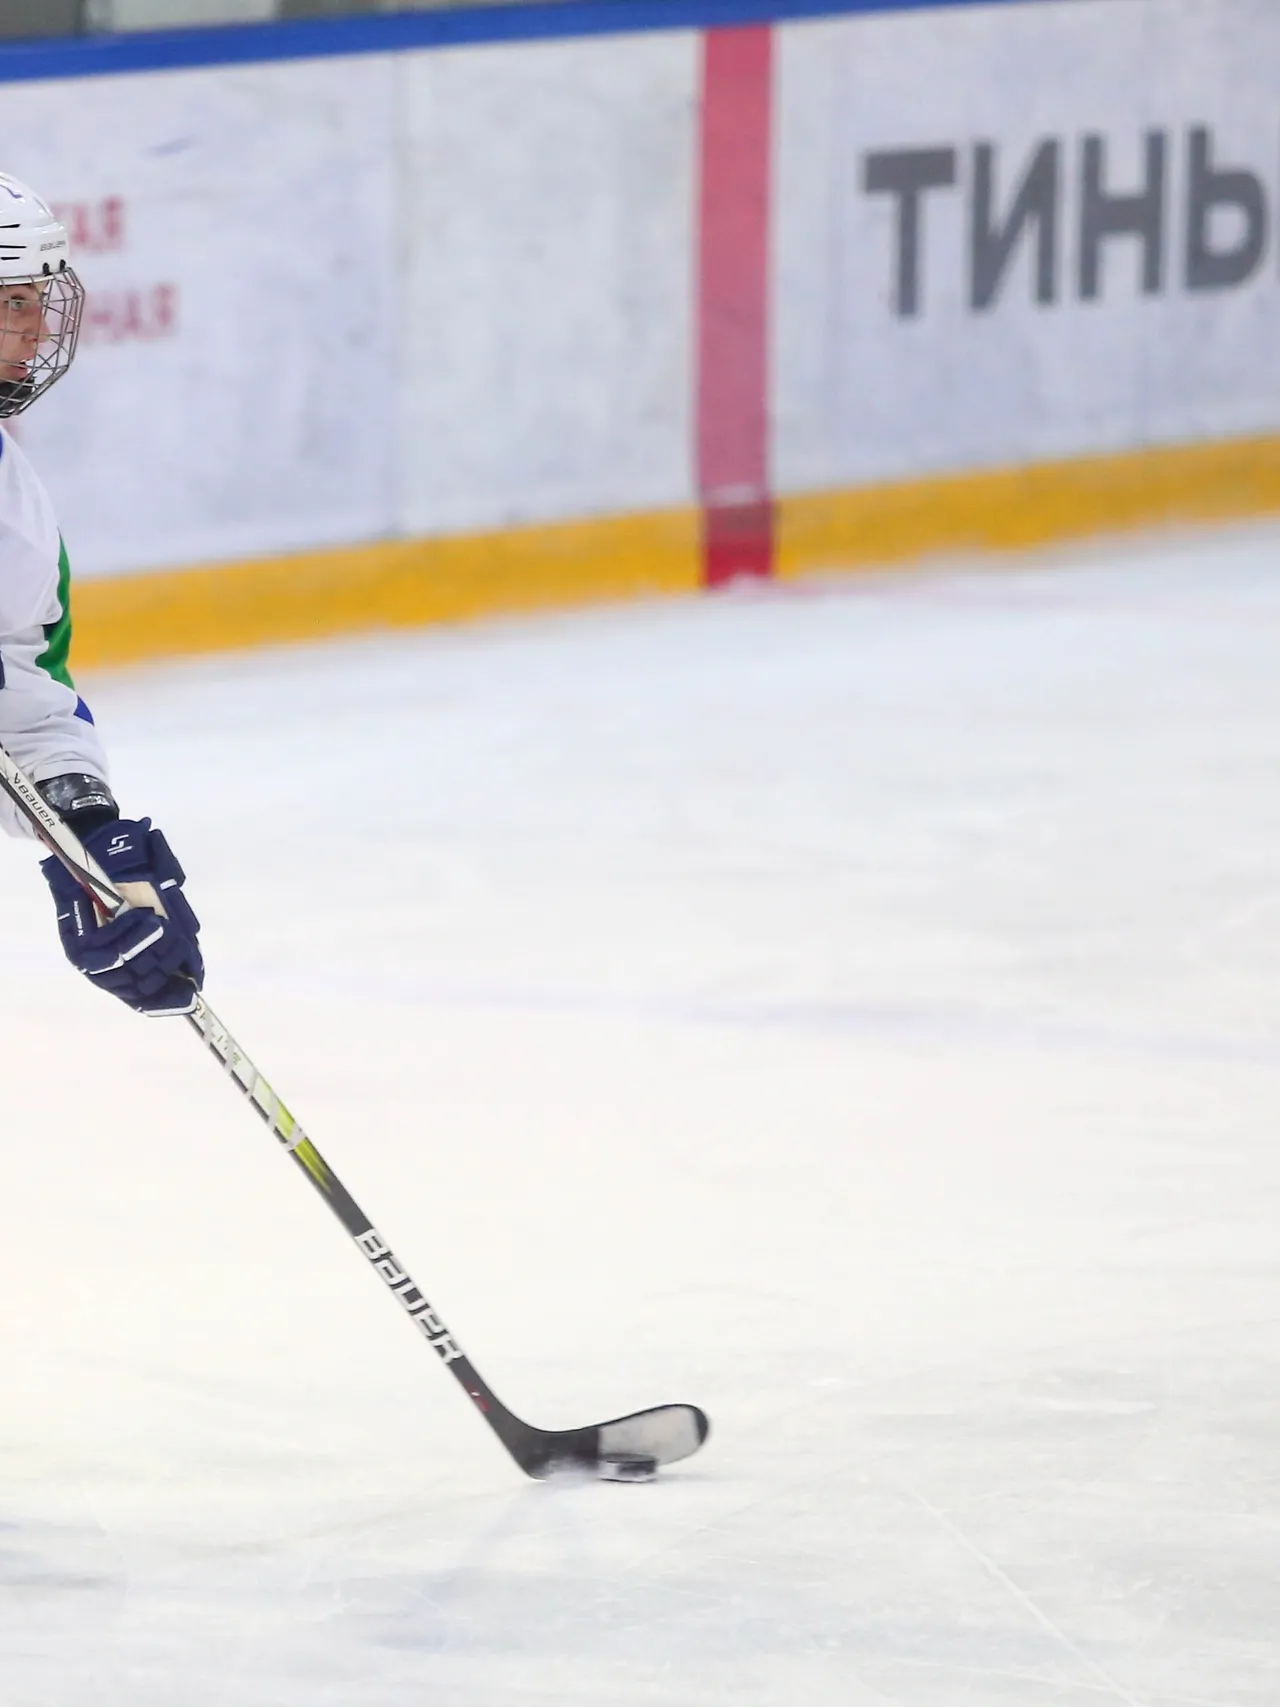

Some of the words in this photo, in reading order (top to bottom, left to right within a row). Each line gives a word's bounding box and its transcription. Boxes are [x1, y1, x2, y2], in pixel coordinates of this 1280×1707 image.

[864, 123, 1280, 318] ТИНЬ
[18, 784, 56, 829] BAUER
[353, 1228, 465, 1366] BAUER
